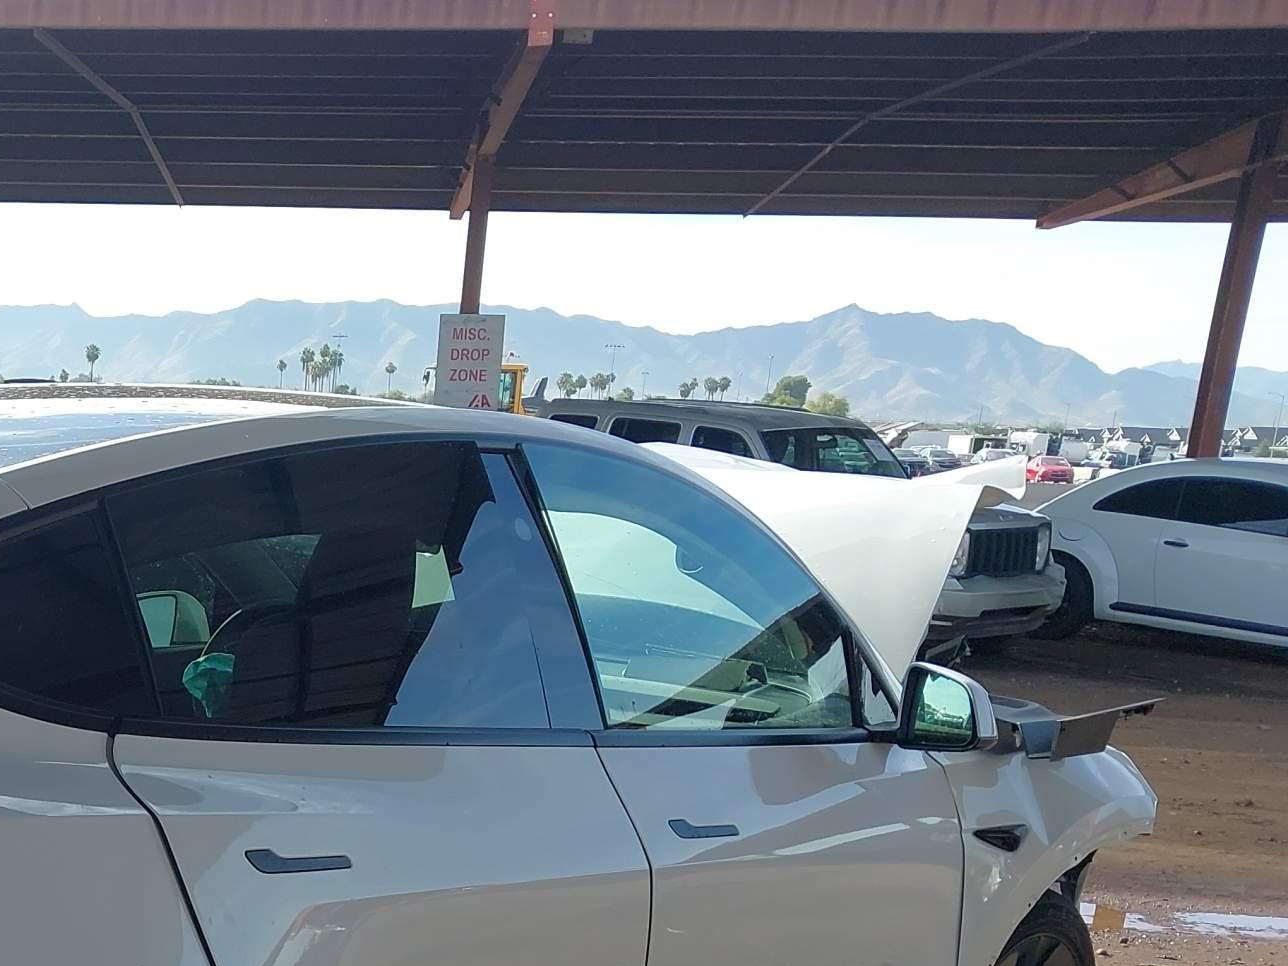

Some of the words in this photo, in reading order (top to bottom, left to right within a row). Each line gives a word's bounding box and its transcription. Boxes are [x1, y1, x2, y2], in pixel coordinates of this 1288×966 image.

[452, 327, 490, 341] MISC.
[450, 348, 490, 361] DROP
[449, 368, 488, 382] ZONE
